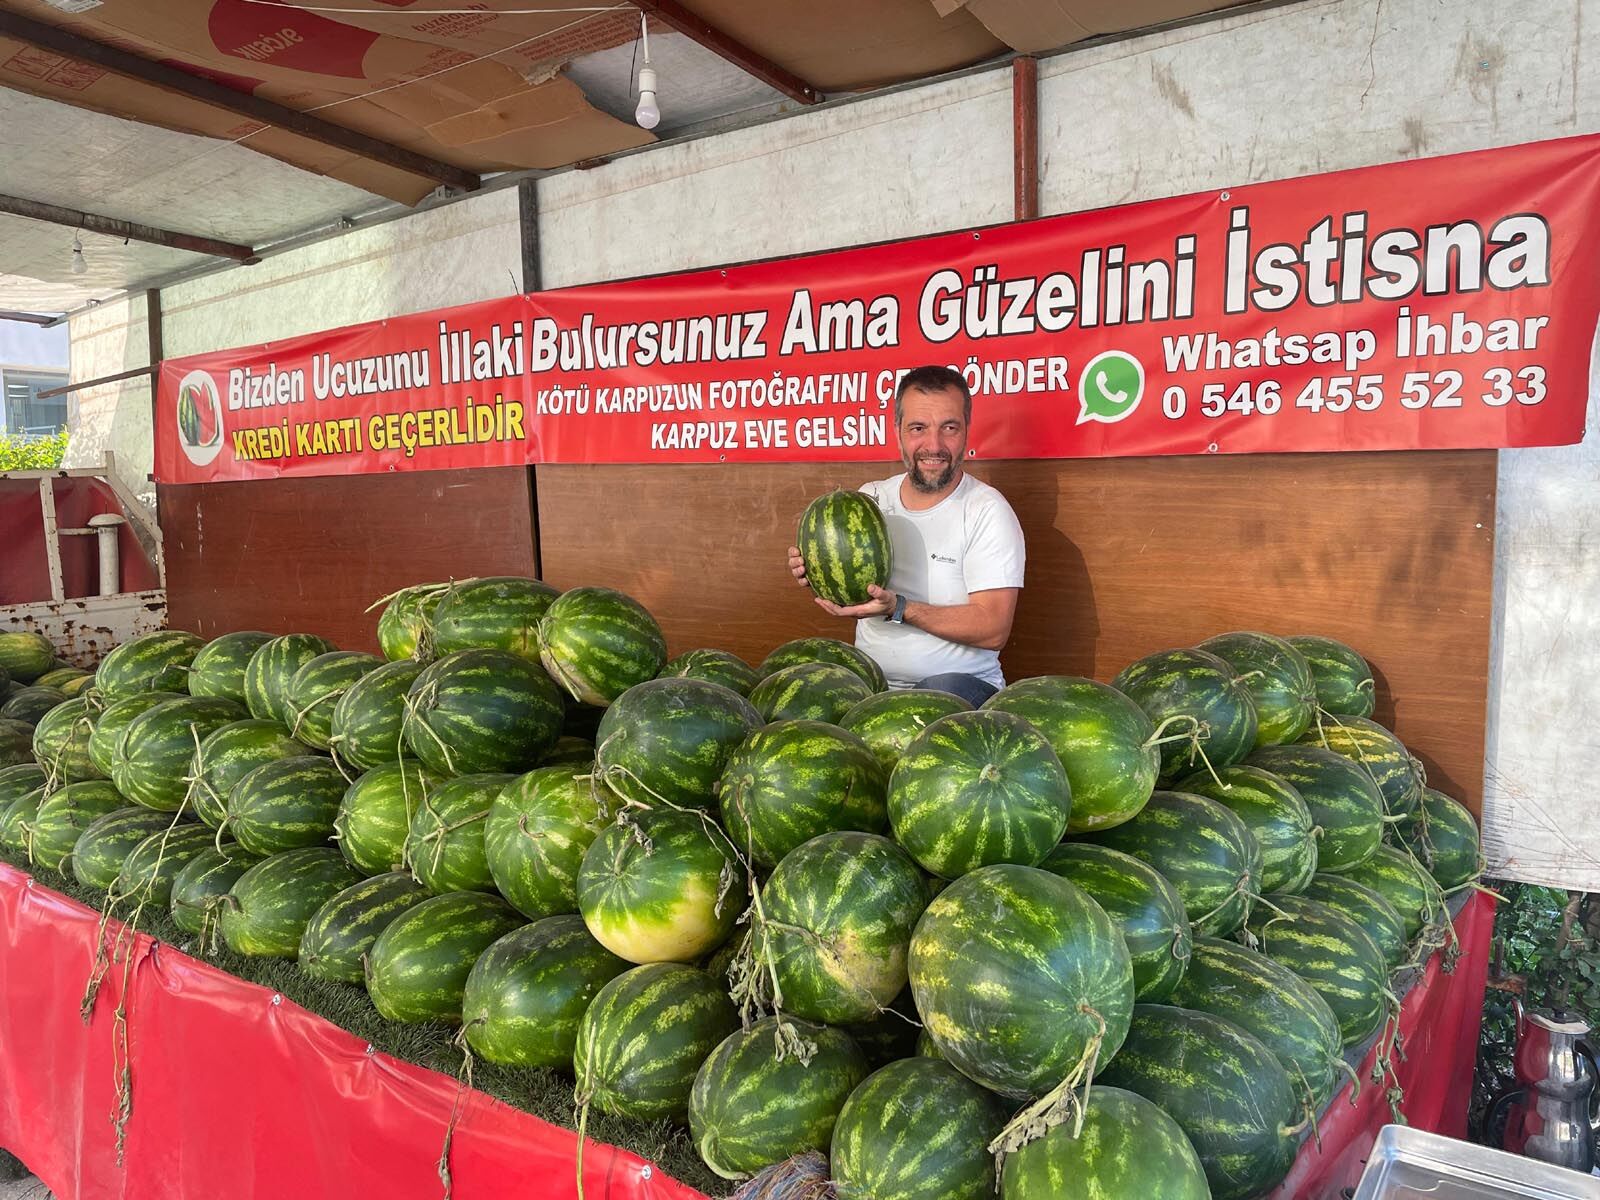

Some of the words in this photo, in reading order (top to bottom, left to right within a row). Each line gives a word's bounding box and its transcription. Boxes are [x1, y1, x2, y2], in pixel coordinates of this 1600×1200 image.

[232, 28, 304, 61] arçelik
[228, 362, 305, 411] Bizden
[312, 348, 430, 400] Ucuzunu
[438, 321, 524, 385] İllaki
[530, 310, 768, 373] Bulursunuz
[779, 288, 900, 355] Ama
[918, 234, 1197, 343] Güzelini
[1224, 206, 1551, 315] İstisna
[1162, 327, 1376, 373] Whatsap
[1396, 306, 1550, 358] İhbar
[536, 384, 590, 415] KÖTÜ
[594, 381, 703, 415] KARPUZUN
[709, 371, 868, 409] FOTOĞRAFINI
[1160, 386, 1188, 420] 0
[1200, 380, 1283, 418] 546
[1296, 374, 1384, 414] 455
[1400, 370, 1465, 410] 52
[1481, 365, 1548, 407] 33
[232, 417, 291, 461] KREDİ
[295, 417, 363, 456] KARTI
[368, 393, 525, 458] GEÇERLİDİR
[651, 421, 739, 450] KARPUZ
[744, 418, 790, 449] EVE
[795, 407, 887, 449] GELSİN
